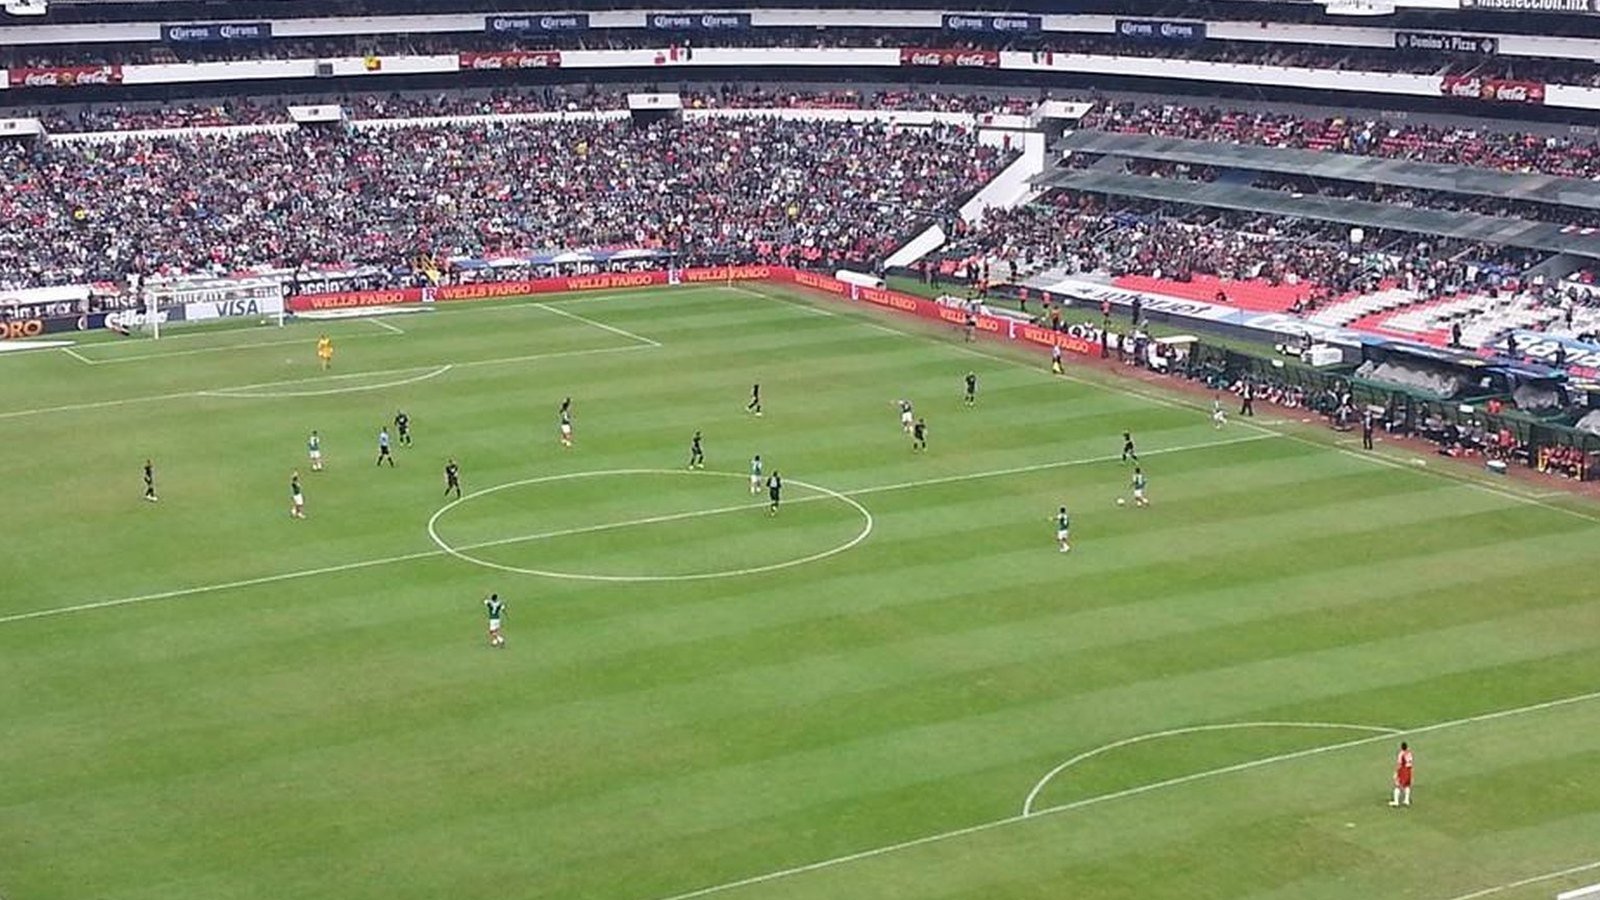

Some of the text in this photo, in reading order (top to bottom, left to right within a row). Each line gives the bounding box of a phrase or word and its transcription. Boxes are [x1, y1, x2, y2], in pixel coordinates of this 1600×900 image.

[1410, 34, 1477, 51] Domino's Pizza
[567, 275, 652, 290] WELLS FARGO
[687, 270, 728, 281] WELLS
[729, 267, 770, 278] FARGO
[794, 272, 818, 286] WELLS
[819, 278, 844, 292] FARGO
[443, 283, 531, 299] WELLS FARGO
[862, 289, 889, 304] WELLS
[890, 295, 917, 310] FARGO
[216, 300, 259, 316] VISA
[310, 292, 404, 309] WELLS FARGO
[1024, 327, 1089, 353] WELLS FARGO
